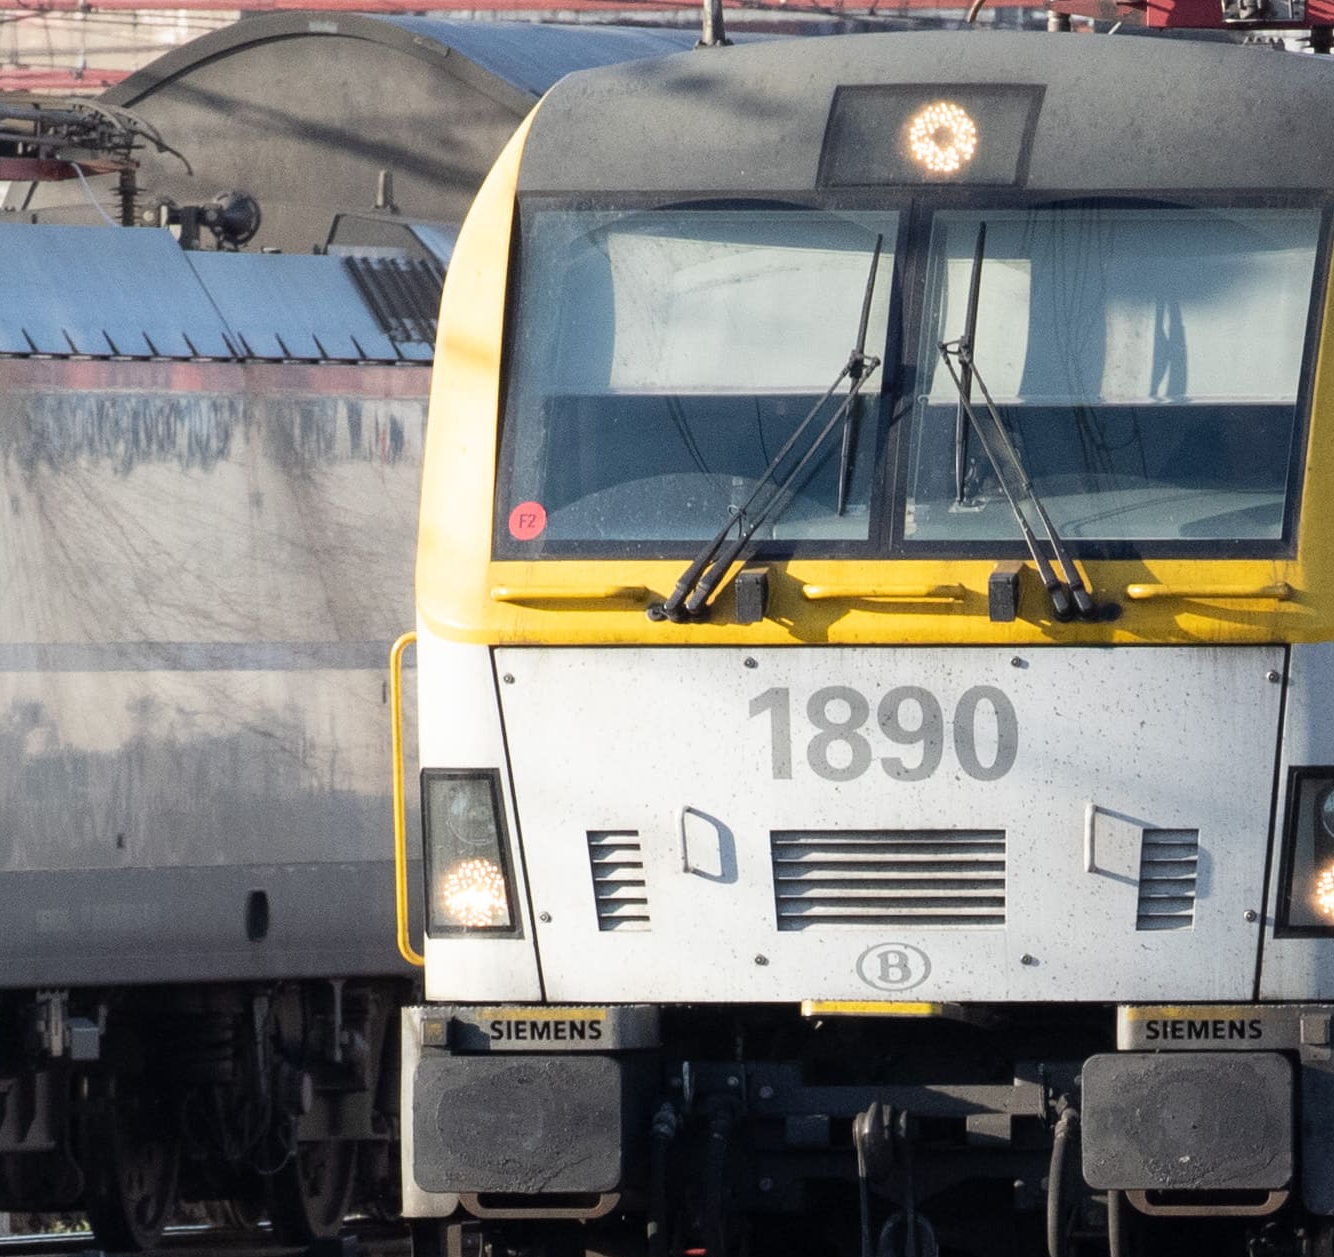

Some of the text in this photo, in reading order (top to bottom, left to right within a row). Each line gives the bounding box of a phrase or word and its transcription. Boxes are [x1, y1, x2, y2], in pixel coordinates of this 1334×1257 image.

[518, 513, 537, 529] F2
[747, 685, 1019, 783] 1890
[490, 1020, 602, 1040] SIEMENS
[1145, 1020, 1263, 1040] SIEMENS
